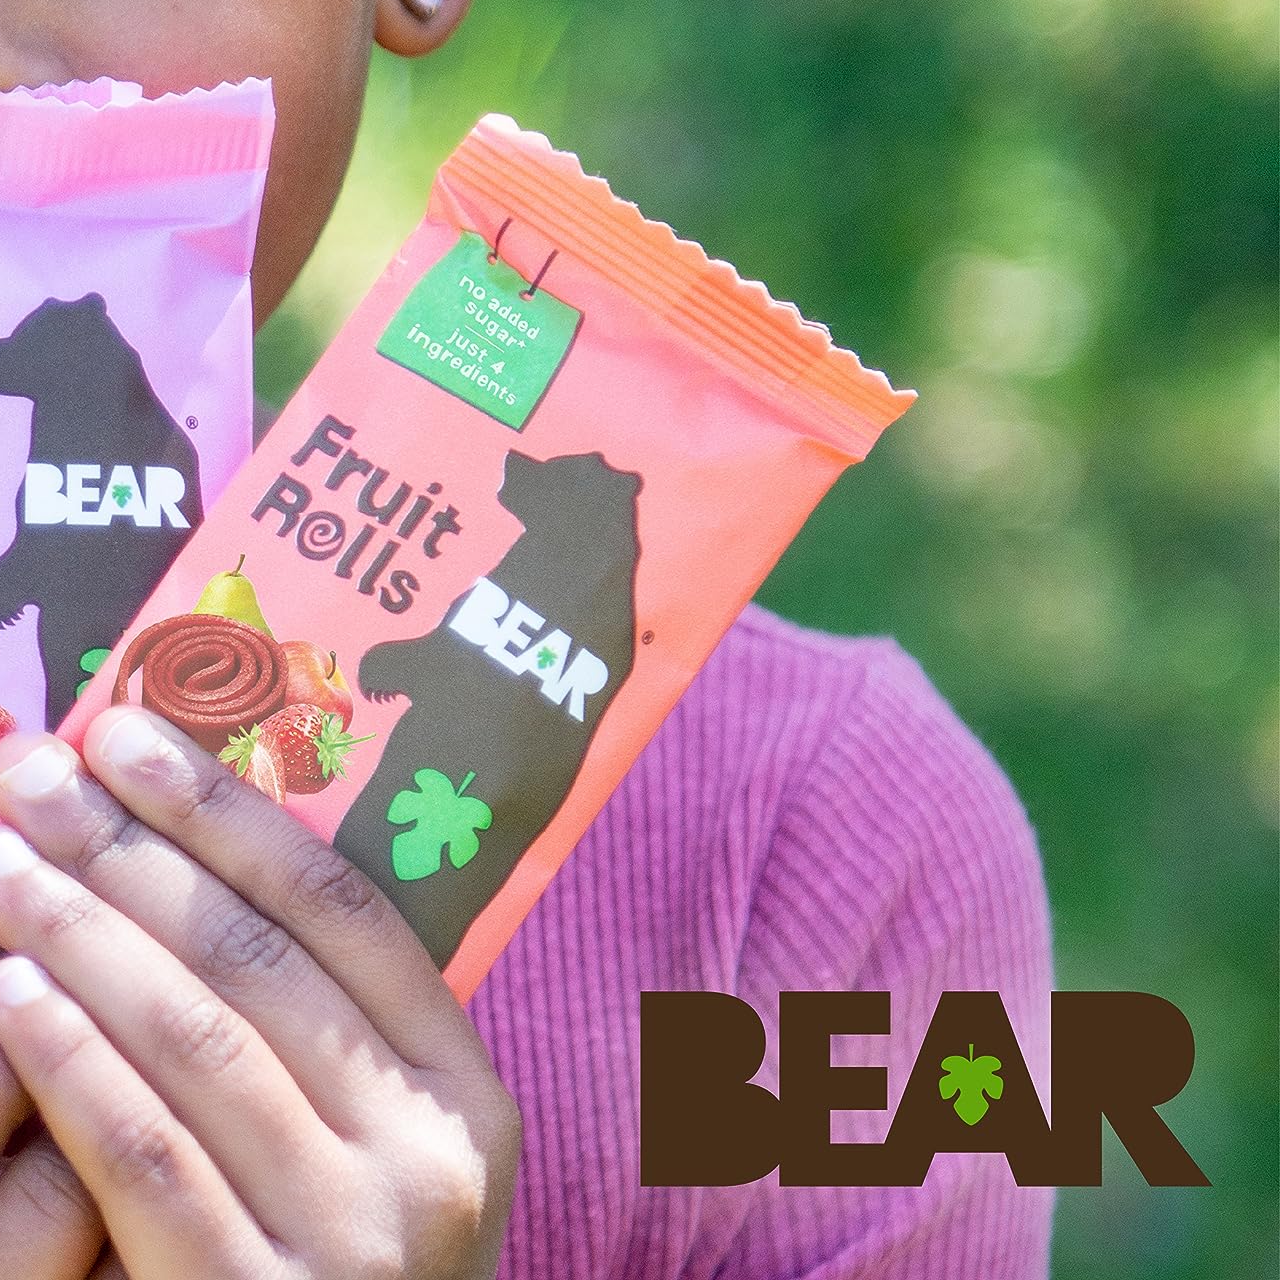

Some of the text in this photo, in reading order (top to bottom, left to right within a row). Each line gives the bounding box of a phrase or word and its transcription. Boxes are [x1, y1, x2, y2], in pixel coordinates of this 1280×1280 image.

[458, 275, 540, 340] no added
[407, 323, 517, 406] ingredients
[445, 327, 506, 375] just 4
[24, 463, 192, 529] BEAR
[290, 414, 463, 559] Fruit
[250, 471, 420, 615] Rolls
[448, 576, 609, 722] BEAR
